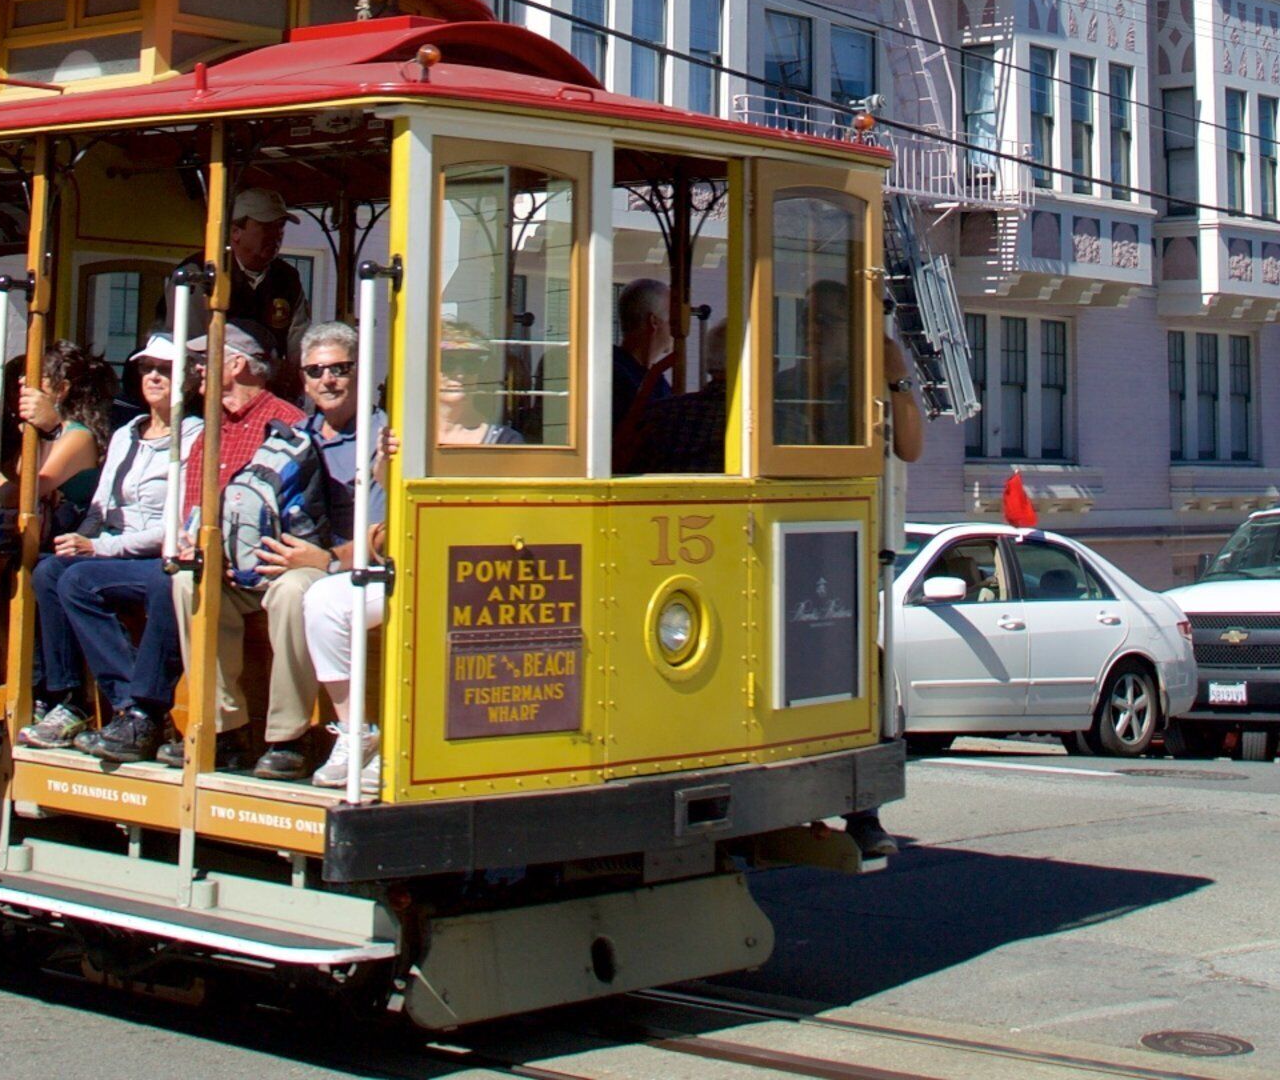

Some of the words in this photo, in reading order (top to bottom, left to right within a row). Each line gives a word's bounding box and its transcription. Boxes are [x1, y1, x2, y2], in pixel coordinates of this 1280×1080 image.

[648, 514, 716, 567] 15
[456, 559, 575, 583] POWELL
[487, 583, 546, 602] AND
[453, 602, 576, 627] MARKET
[455, 654, 497, 681] HYDE
[523, 651, 576, 678] BEACH
[464, 683, 565, 705] FISHERMANS
[488, 703, 540, 723] WHARF
[47, 779, 69, 793] TWO
[71, 783, 119, 802] STANDEES
[121, 792, 148, 806] ONLY
[210, 805, 236, 820] TWO
[238, 810, 292, 830] STANDEES
[295, 818, 326, 834] ONLY
